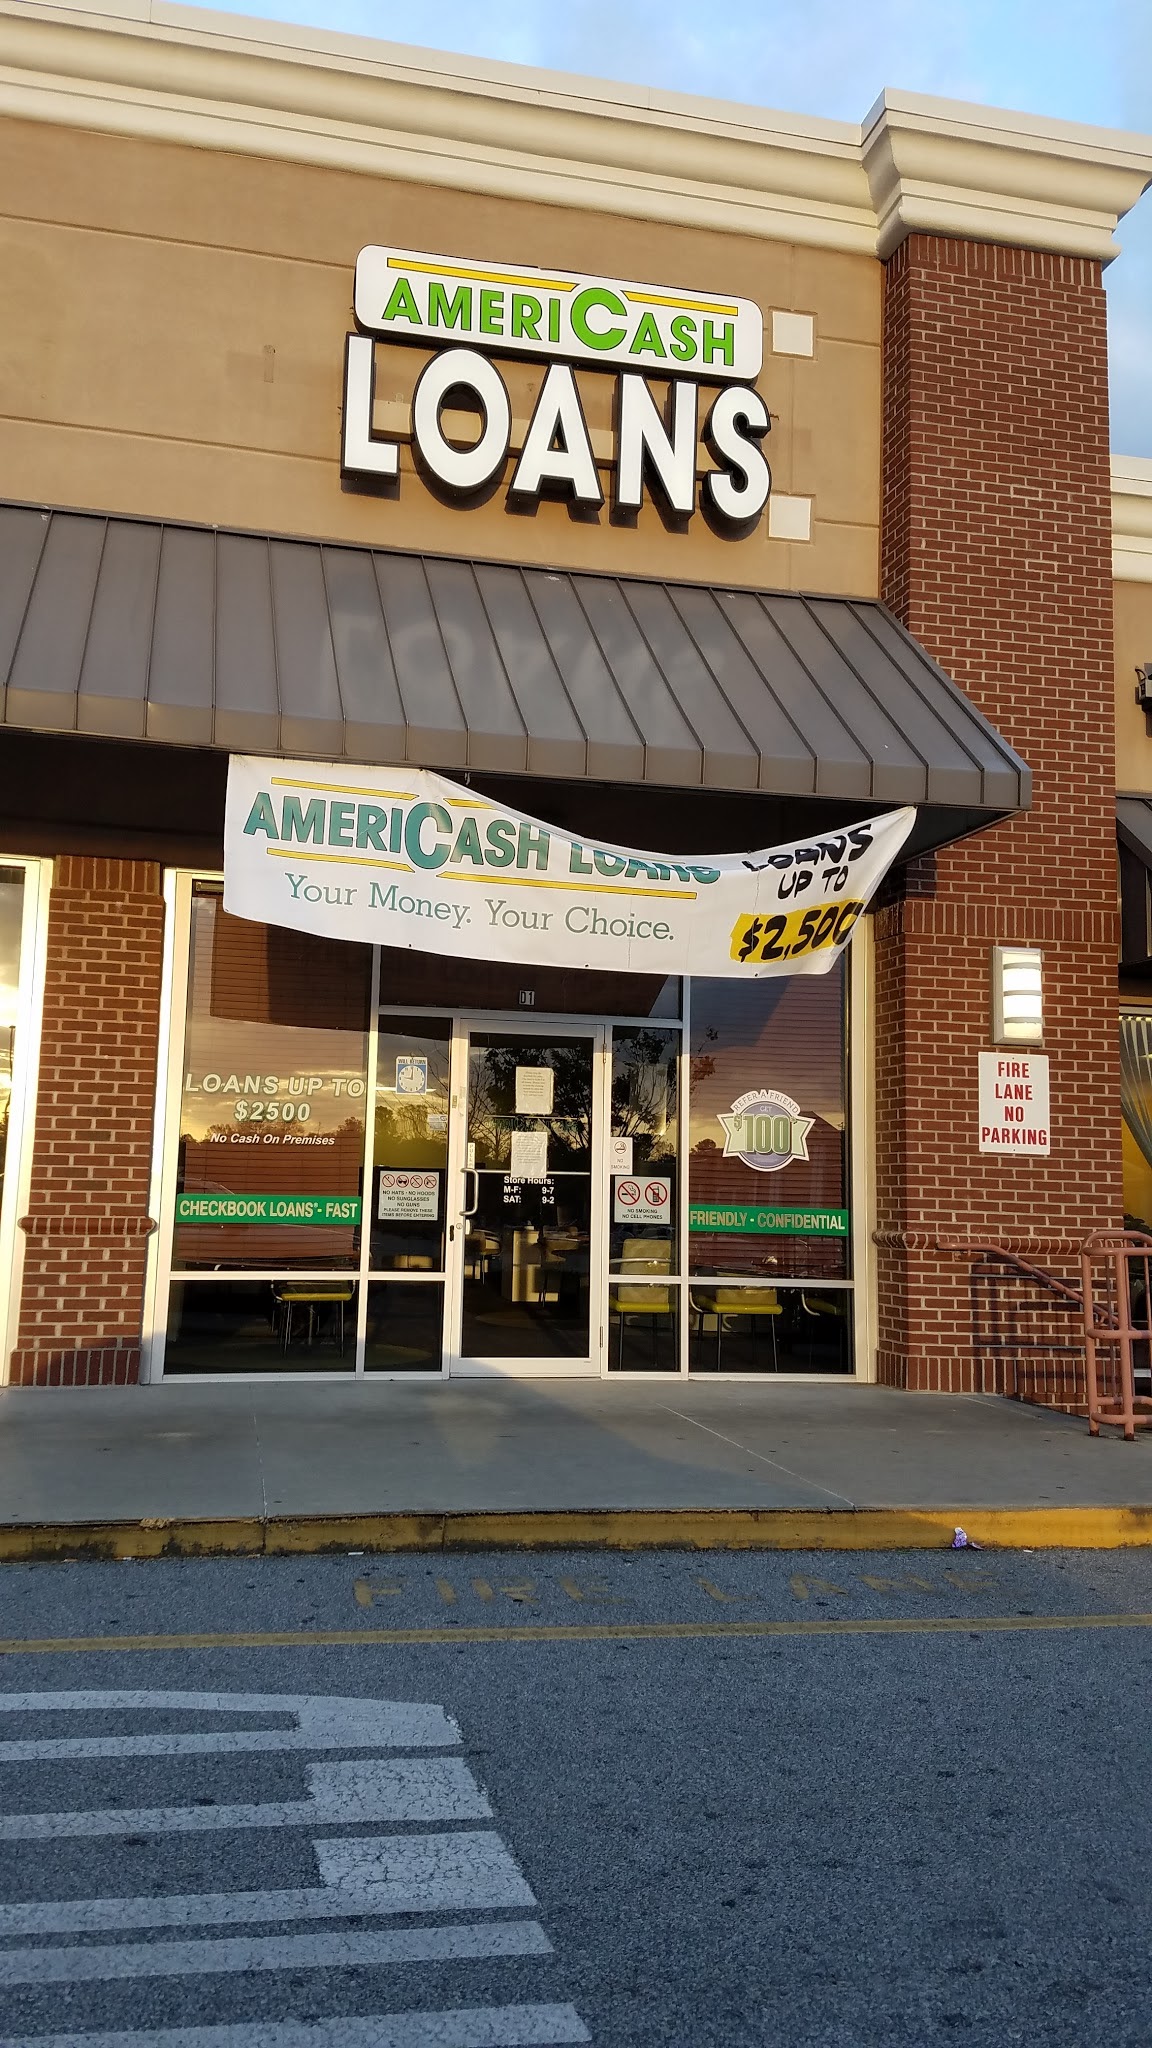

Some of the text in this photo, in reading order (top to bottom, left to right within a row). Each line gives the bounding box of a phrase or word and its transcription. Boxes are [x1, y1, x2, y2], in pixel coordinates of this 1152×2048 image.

[381, 277, 735, 367] AMERICASH
[341, 333, 772, 521] LOANS
[243, 792, 551, 870] AMERICASH
[741, 824, 874, 872] LOANS
[777, 865, 849, 899] UP TO
[285, 872, 674, 941] Your Money. Your Choice.
[738, 901, 865, 962] $2,500
[997, 1061, 1030, 1078] FIRE
[185, 1073, 365, 1098] LOANS UP TO
[995, 1083, 1033, 1100] LANE
[234, 1100, 311, 1122] $2500
[733, 1092, 758, 1111] REFER
[769, 1092, 799, 1114] FRIEND
[1004, 1105, 1024, 1122] NO
[210, 1133, 335, 1146] No Cash On Premises
[981, 1126, 1047, 1146] PARKING
[503, 1175, 555, 1185] Store Hours:
[503, 1186, 555, 1194] M-F: 9-7
[179, 1200, 266, 1217] CHECKBOOK
[325, 1202, 358, 1218] FAST
[503, 1195, 555, 1204] SAT: 9-2
[689, 1210, 748, 1227] FRIENDLY
[757, 1212, 845, 1230] CONFIDENTIAL
